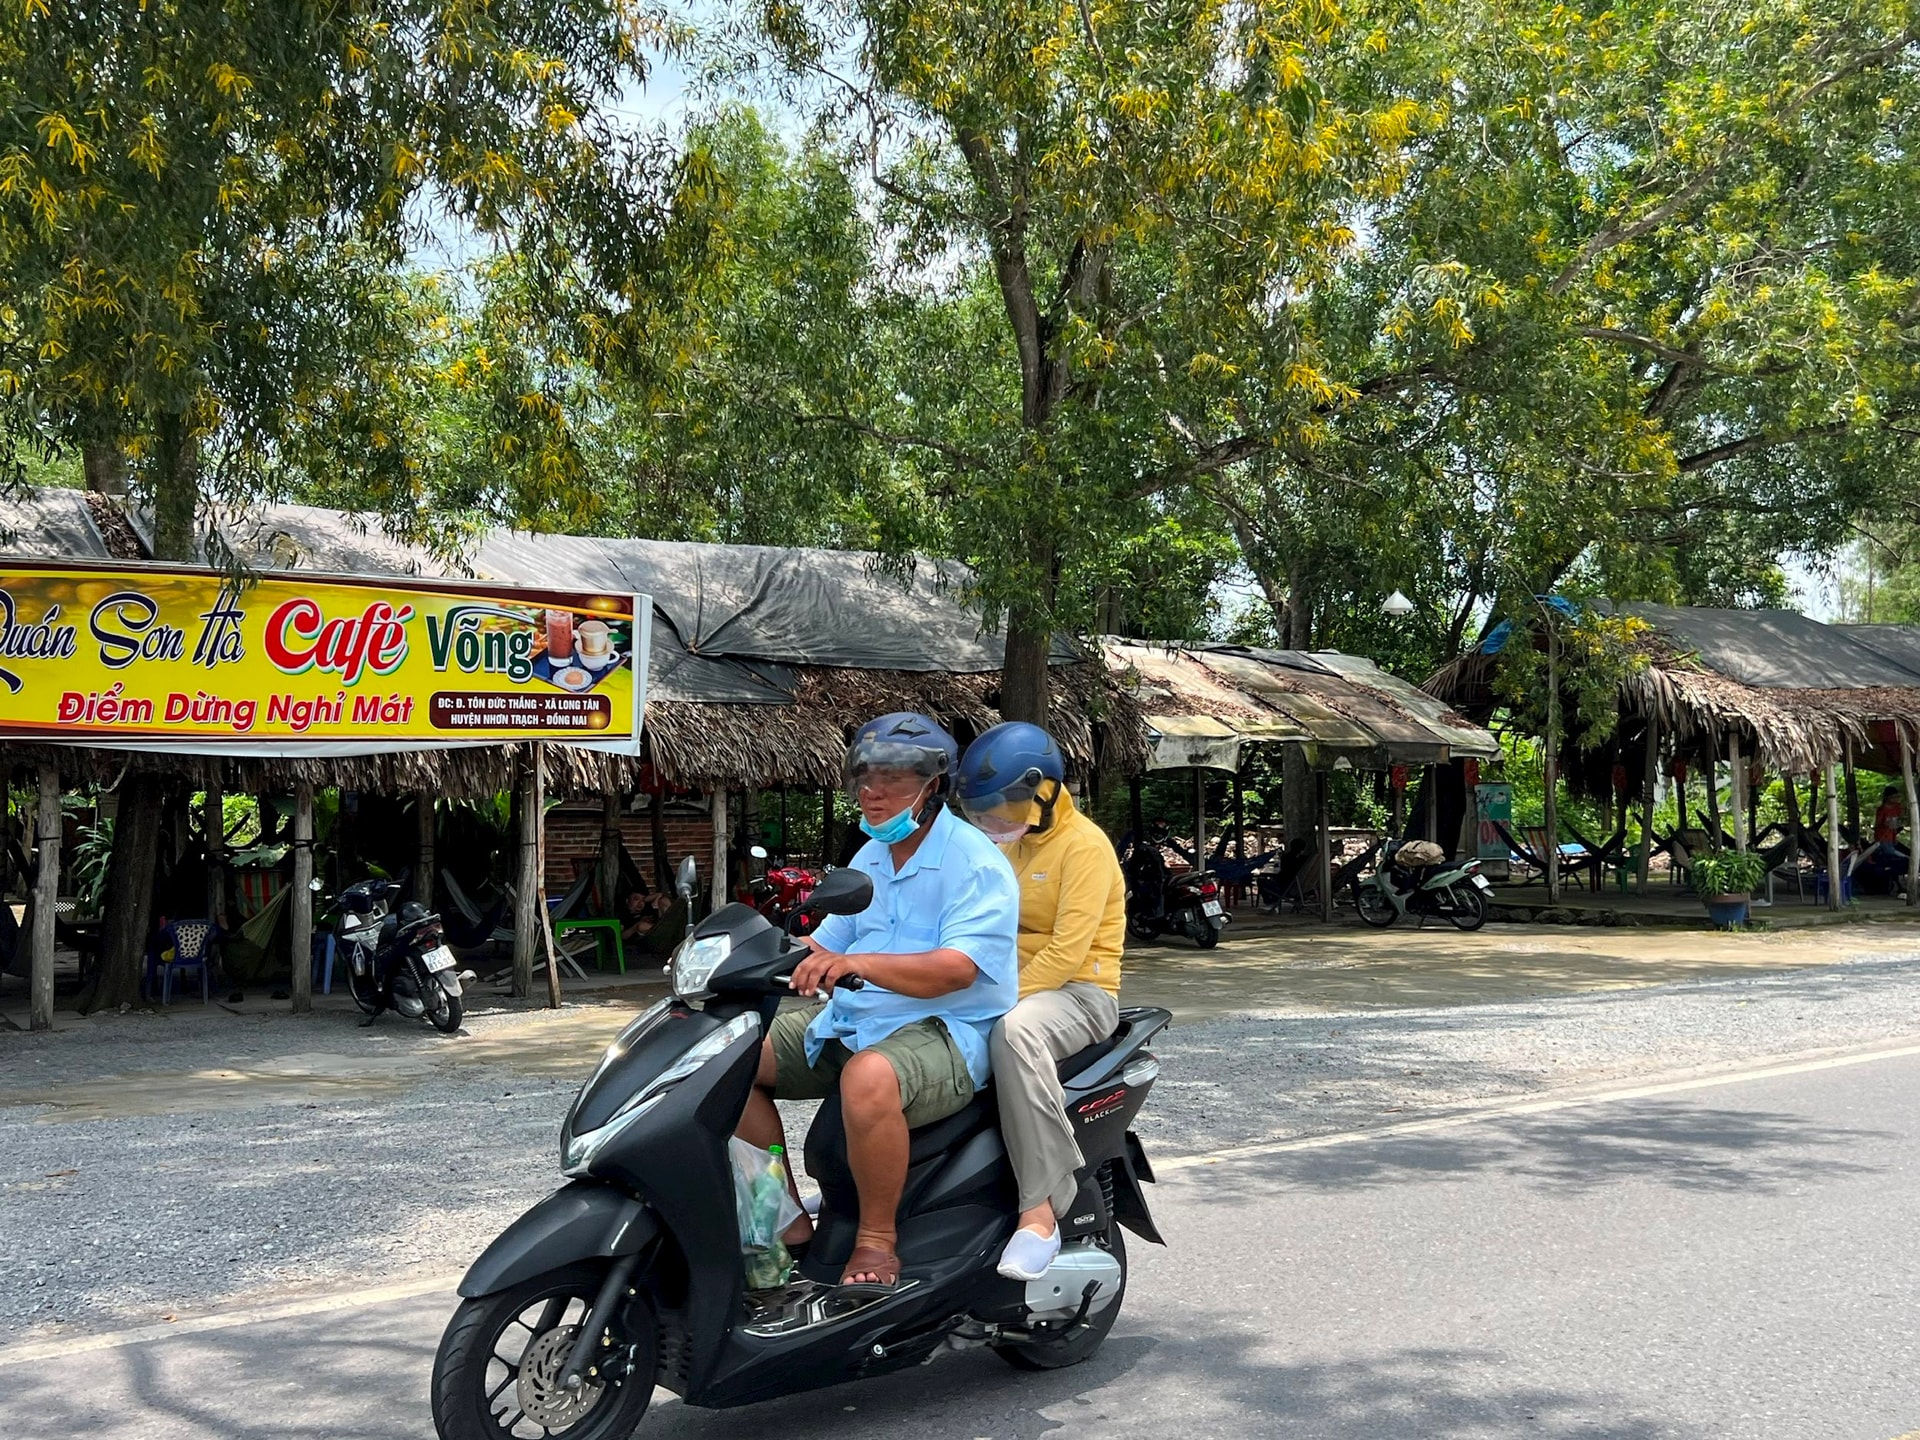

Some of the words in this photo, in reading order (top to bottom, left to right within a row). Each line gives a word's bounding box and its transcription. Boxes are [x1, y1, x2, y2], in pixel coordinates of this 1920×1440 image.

[90, 591, 185, 669] Sơn
[192, 586, 245, 669] Hà
[264, 597, 415, 687] Café
[426, 605, 535, 683] Võng
[57, 681, 154, 724] Điểm
[163, 690, 256, 733] Dừng
[266, 690, 347, 732] Nghỉ
[351, 692, 414, 724] Mát
[468, 696, 486, 709] TÔN
[487, 697, 506, 709] ĐỨC
[544, 697, 557, 710] XÃ
[558, 699, 581, 710] LONG
[582, 698, 600, 711] TÂN
[450, 712, 481, 727] HUYỆN
[483, 713, 509, 725] NHƠN
[511, 714, 539, 727] TRẠCH
[571, 715, 588, 726] NAI
[1084, 1109, 1111, 1124] BLACK
